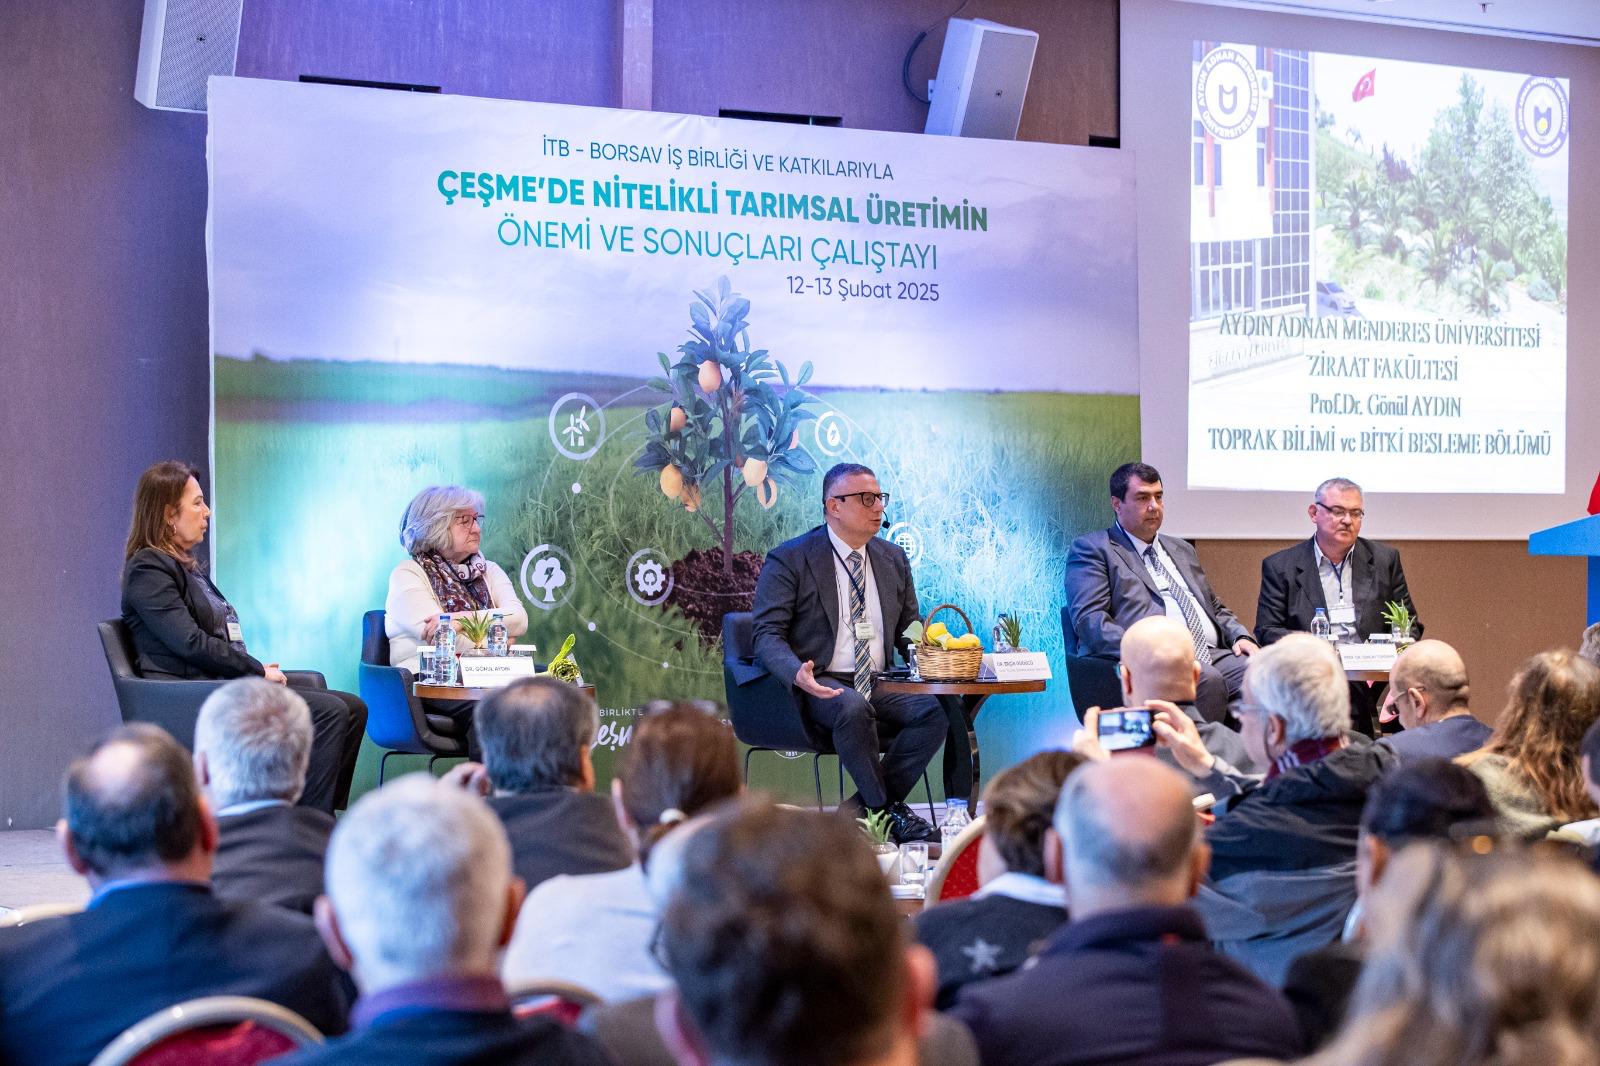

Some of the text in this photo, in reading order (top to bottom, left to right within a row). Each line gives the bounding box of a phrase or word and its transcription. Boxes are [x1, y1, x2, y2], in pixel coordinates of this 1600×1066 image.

[543, 134, 570, 157] İTB
[590, 142, 662, 164] BORSAV
[668, 143, 683, 170] İŞ
[688, 146, 748, 170] BİRLİĞİ
[753, 154, 774, 171] VE
[780, 156, 894, 181] KATKILARIYLA
[437, 169, 988, 232] ÇEŞME'DE NİTELİKLİ TARIMSAL ÜRETİMİN
[497, 212, 937, 274] ÖNEMİ VE SONUÇLARI ÇALIŞTAYI
[786, 275, 940, 302] 12-13 Şubat 2025
[1219, 313, 1542, 348] AYDIN ADNAN MENDERES ÜNİVERSİTESİ
[1306, 350, 1370, 378] ZİRAAT
[1373, 354, 1458, 382] FAKÜLTESİ
[1367, 393, 1408, 417] Gönül
[1411, 395, 1462, 418] AYDIN
[1207, 427, 1279, 451] TOPRAK
[1282, 424, 1335, 452] BİLİMİ
[1360, 426, 1404, 453] BİTKİ
[1408, 432, 1481, 455] BESLEME
[1485, 429, 1551, 456] BÖLÜMÜ
